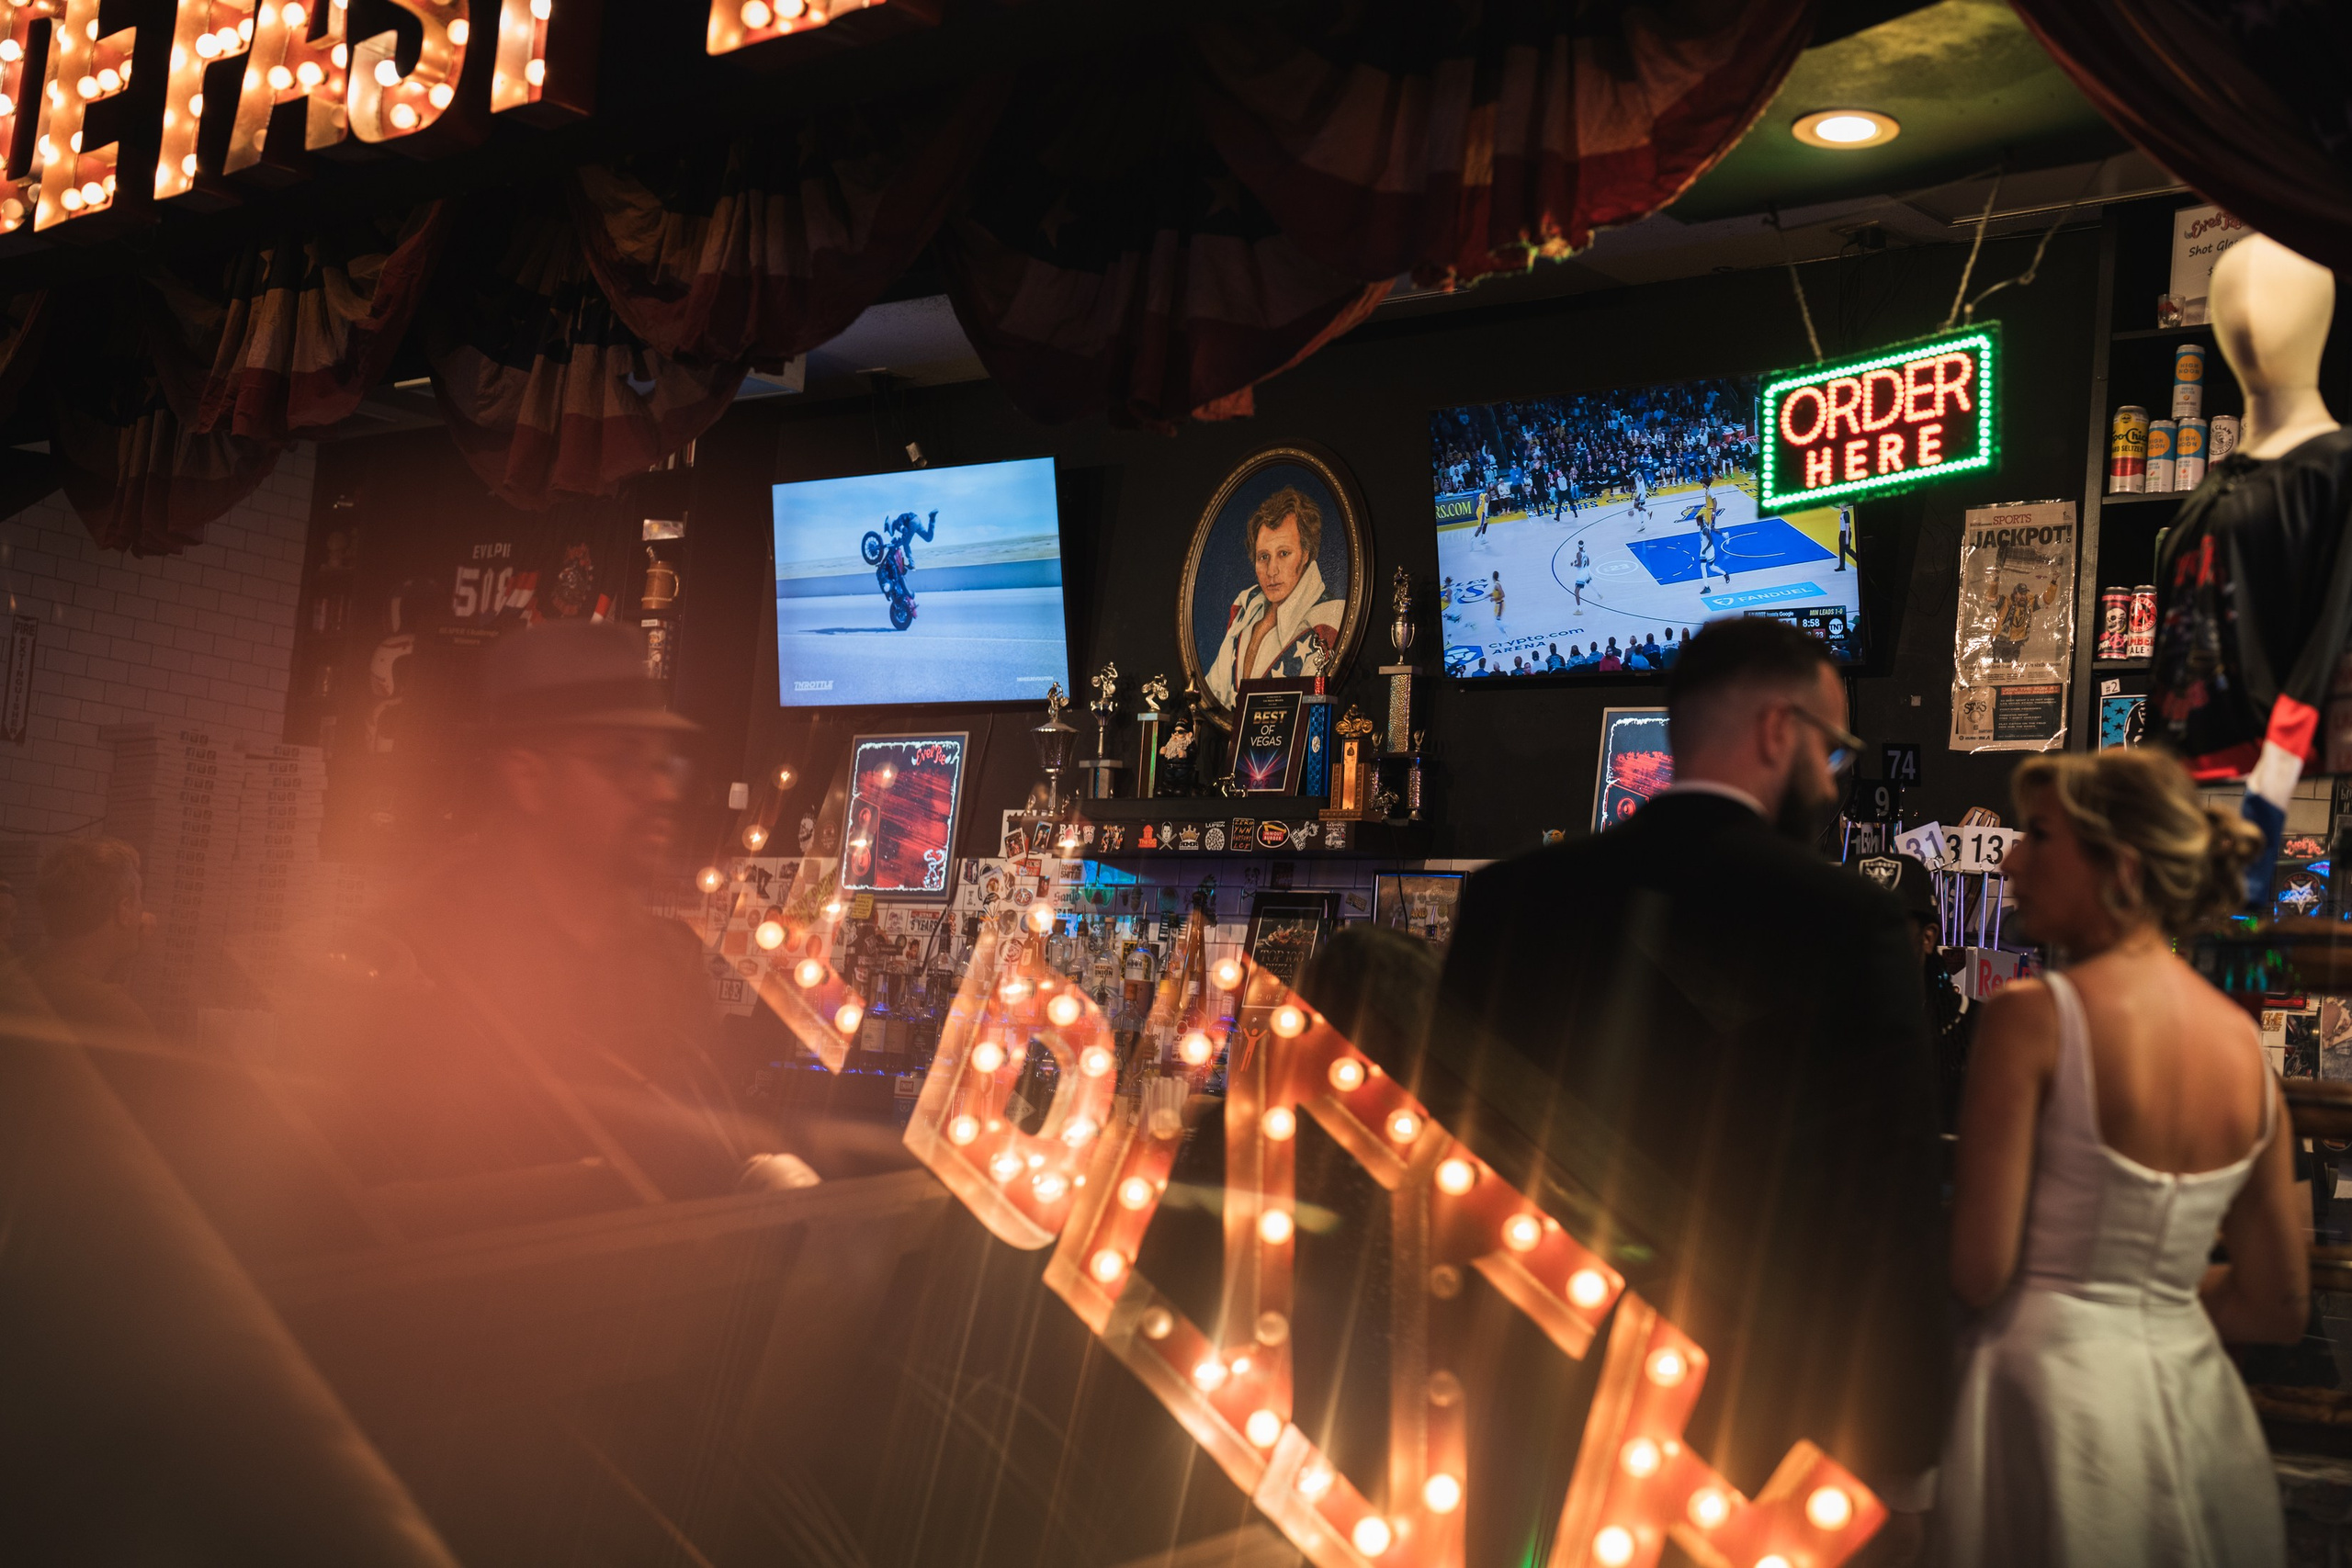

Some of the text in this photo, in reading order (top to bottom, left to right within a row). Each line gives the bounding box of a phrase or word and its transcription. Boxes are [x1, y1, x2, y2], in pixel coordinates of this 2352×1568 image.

[2188, 243, 2213, 257] Shot
[1780, 351, 1973, 446] ORDER
[1804, 423, 1944, 489] HERE
[1993, 513, 2031, 526] SPORTS
[1969, 525, 2073, 549] JACKPOT!
[1737, 587, 1814, 603] FANDUEL
[14, 621, 36, 637] FIRE
[1802, 618, 1820, 627] 8:58
[1488, 627, 1584, 649] crypto.com
[1491, 641, 1547, 655] ARENA
[2129, 646, 2145, 654] ALE
[794, 680, 834, 691] THROTTLE
[2105, 682, 2119, 694] #2
[1253, 710, 1287, 725] BEST
[1261, 725, 1275, 736] OF
[1250, 736, 1283, 747] VEGAS
[915, 745, 947, 766] Evel Pie
[1886, 750, 1917, 780] 74
[1875, 786, 1890, 817] 9
[1905, 830, 1941, 866] 31
[1971, 833, 2004, 865] 13
[1410, 908, 1428, 919] AND
[1260, 949, 1305, 963] TOP 100
